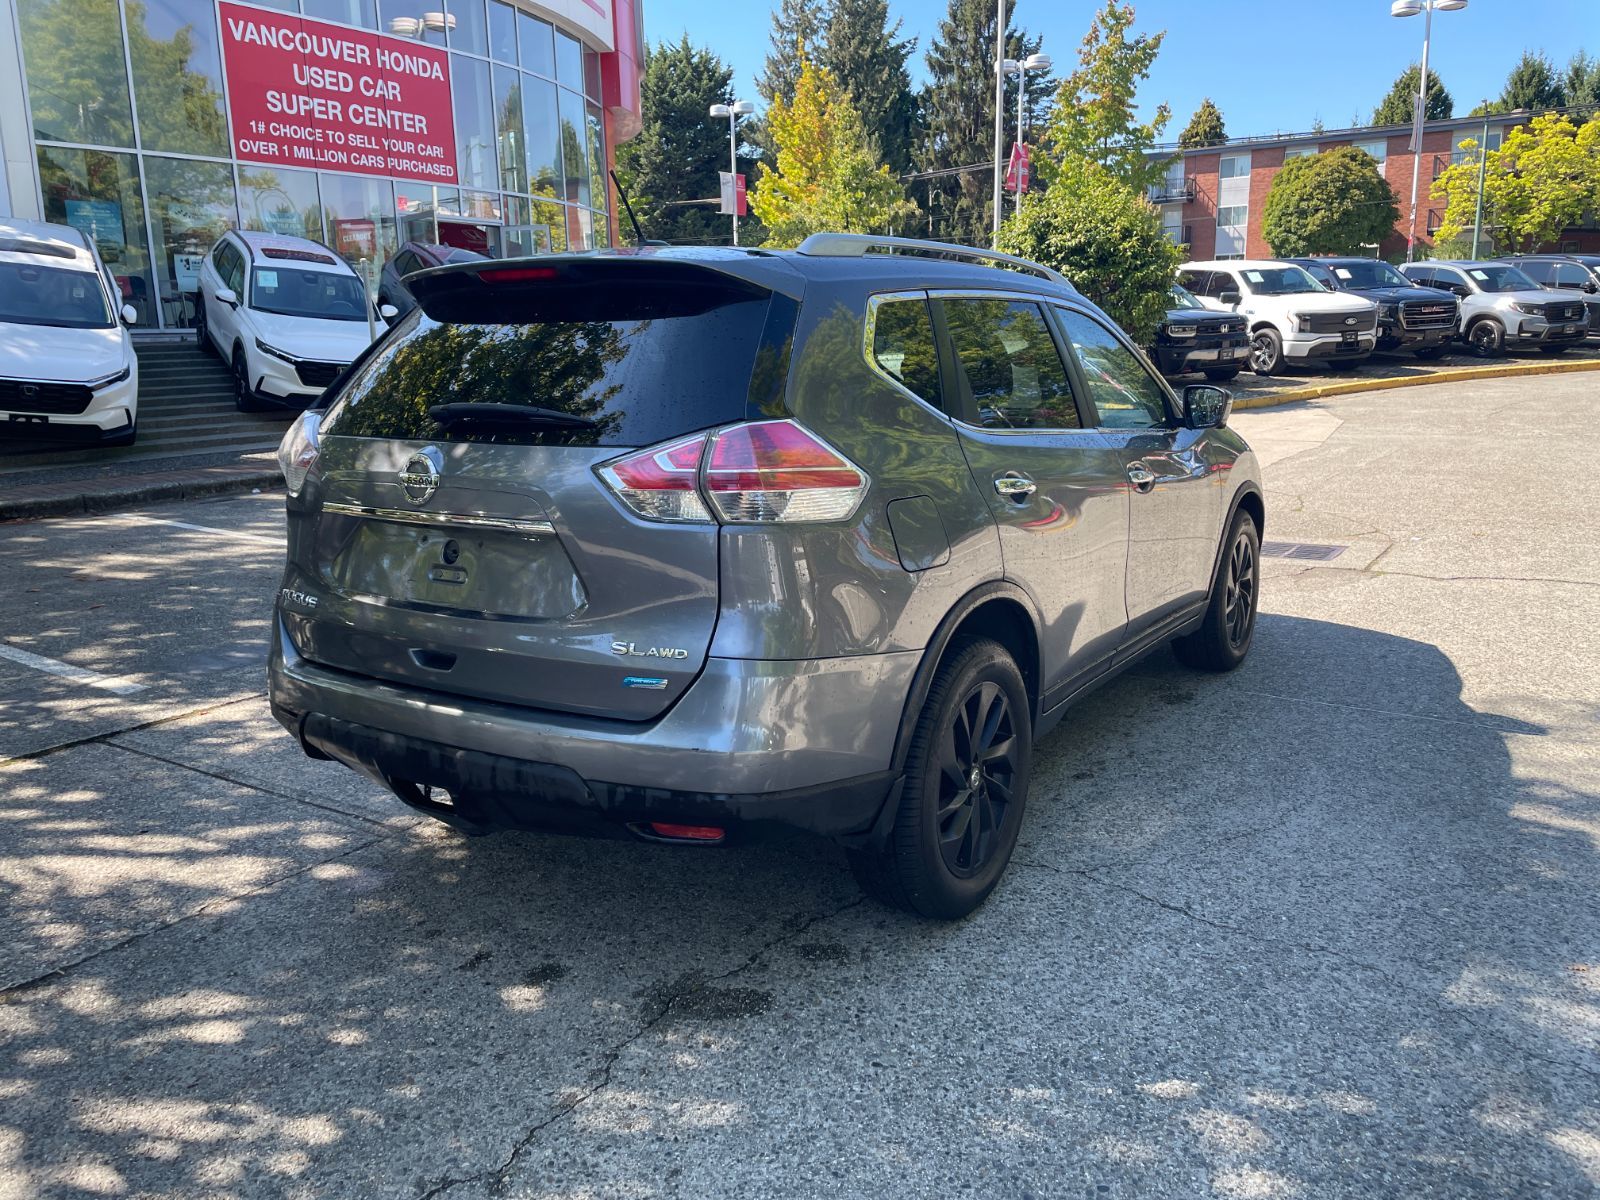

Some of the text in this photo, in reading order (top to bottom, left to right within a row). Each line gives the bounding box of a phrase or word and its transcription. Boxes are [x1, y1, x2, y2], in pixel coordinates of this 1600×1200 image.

[227, 18, 444, 81] VANCOUVER HONDA
[293, 63, 401, 102] USED CAR
[266, 91, 428, 134] SUPER CENTER
[239, 139, 454, 177] OVER 1 MILLION CARS PURCHASED
[250, 121, 444, 158] 1# CHOICE TO SELL YOUR CAR!
[401, 474, 432, 487] SSAN
